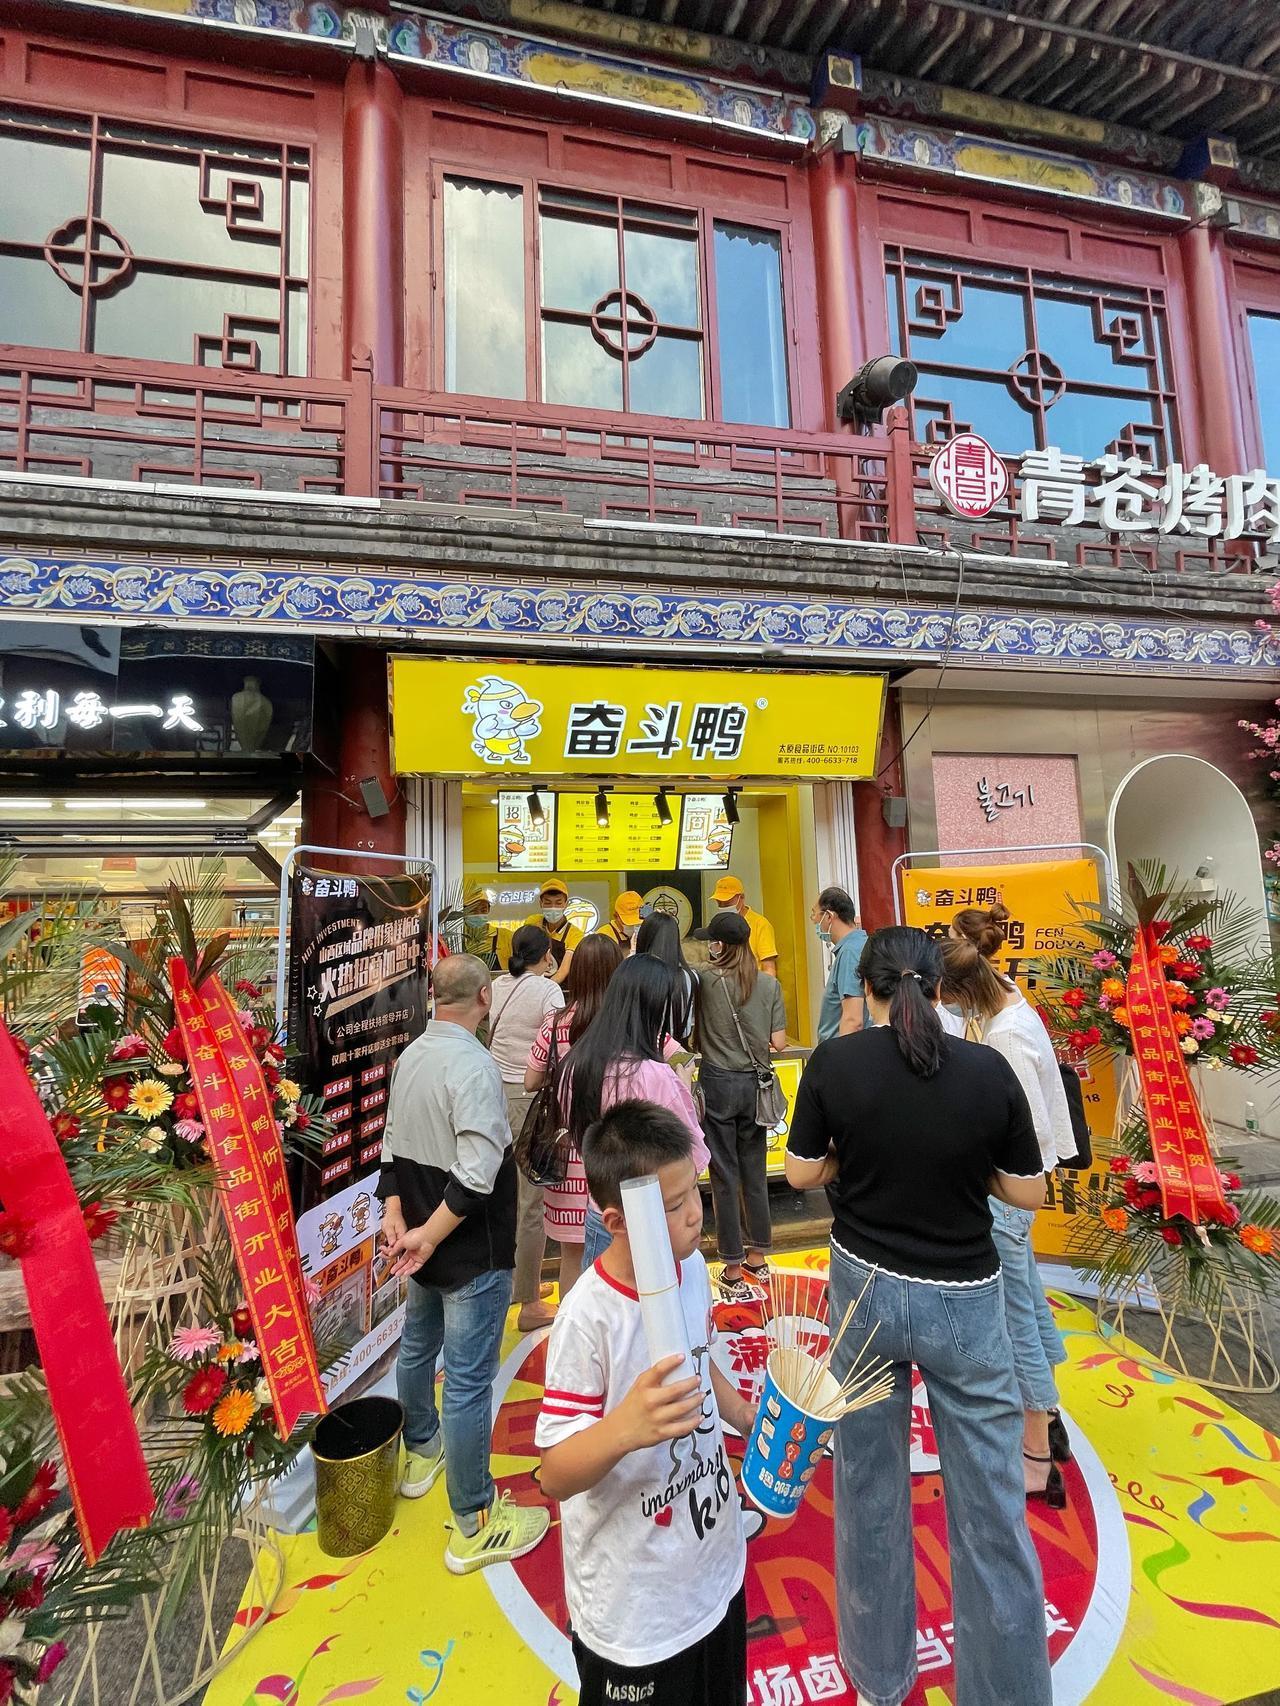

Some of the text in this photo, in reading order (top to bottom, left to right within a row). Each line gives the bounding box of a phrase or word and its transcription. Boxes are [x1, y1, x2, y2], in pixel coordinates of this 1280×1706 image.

[1018, 446, 1280, 543] 青苍烤肉
[0, 689, 204, 731] 利每一天
[564, 700, 748, 761] 奋斗鸭
[778, 744, 825, 754] 太原食品街店
[977, 776, 1034, 822] 불고기
[315, 879, 356, 898] 奋斗鸭
[935, 887, 997, 907] 奋斗鸭
[316, 918, 361, 945] INVESTMENT
[1035, 927, 1064, 938] FEN
[320, 939, 420, 1003] 火热招商加盟中
[605, 1678, 655, 1702] KASSICS
